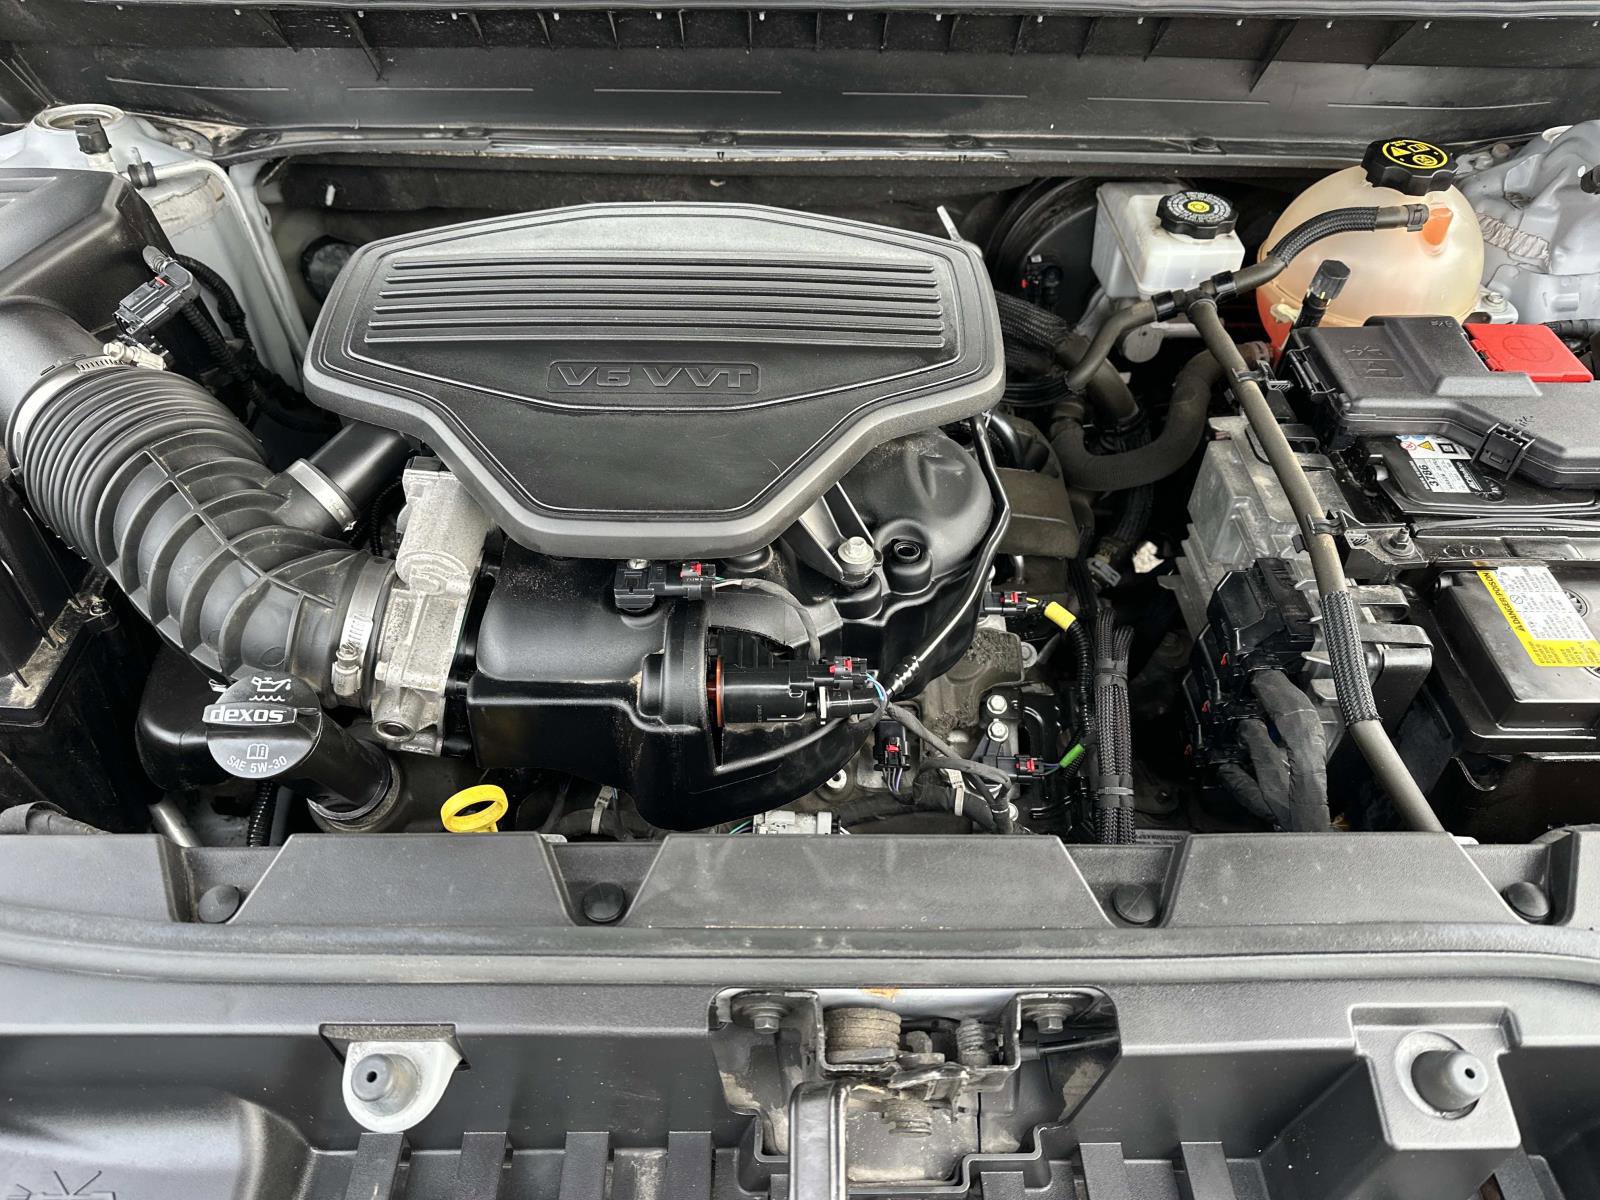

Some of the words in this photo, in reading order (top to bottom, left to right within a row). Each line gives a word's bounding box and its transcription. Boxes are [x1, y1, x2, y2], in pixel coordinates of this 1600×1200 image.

[557, 366, 631, 388] V6
[643, 366, 752, 388] VVT
[209, 705, 285, 722] dexos
[227, 755, 247, 772] SAE
[250, 755, 288, 773] 5W-30
